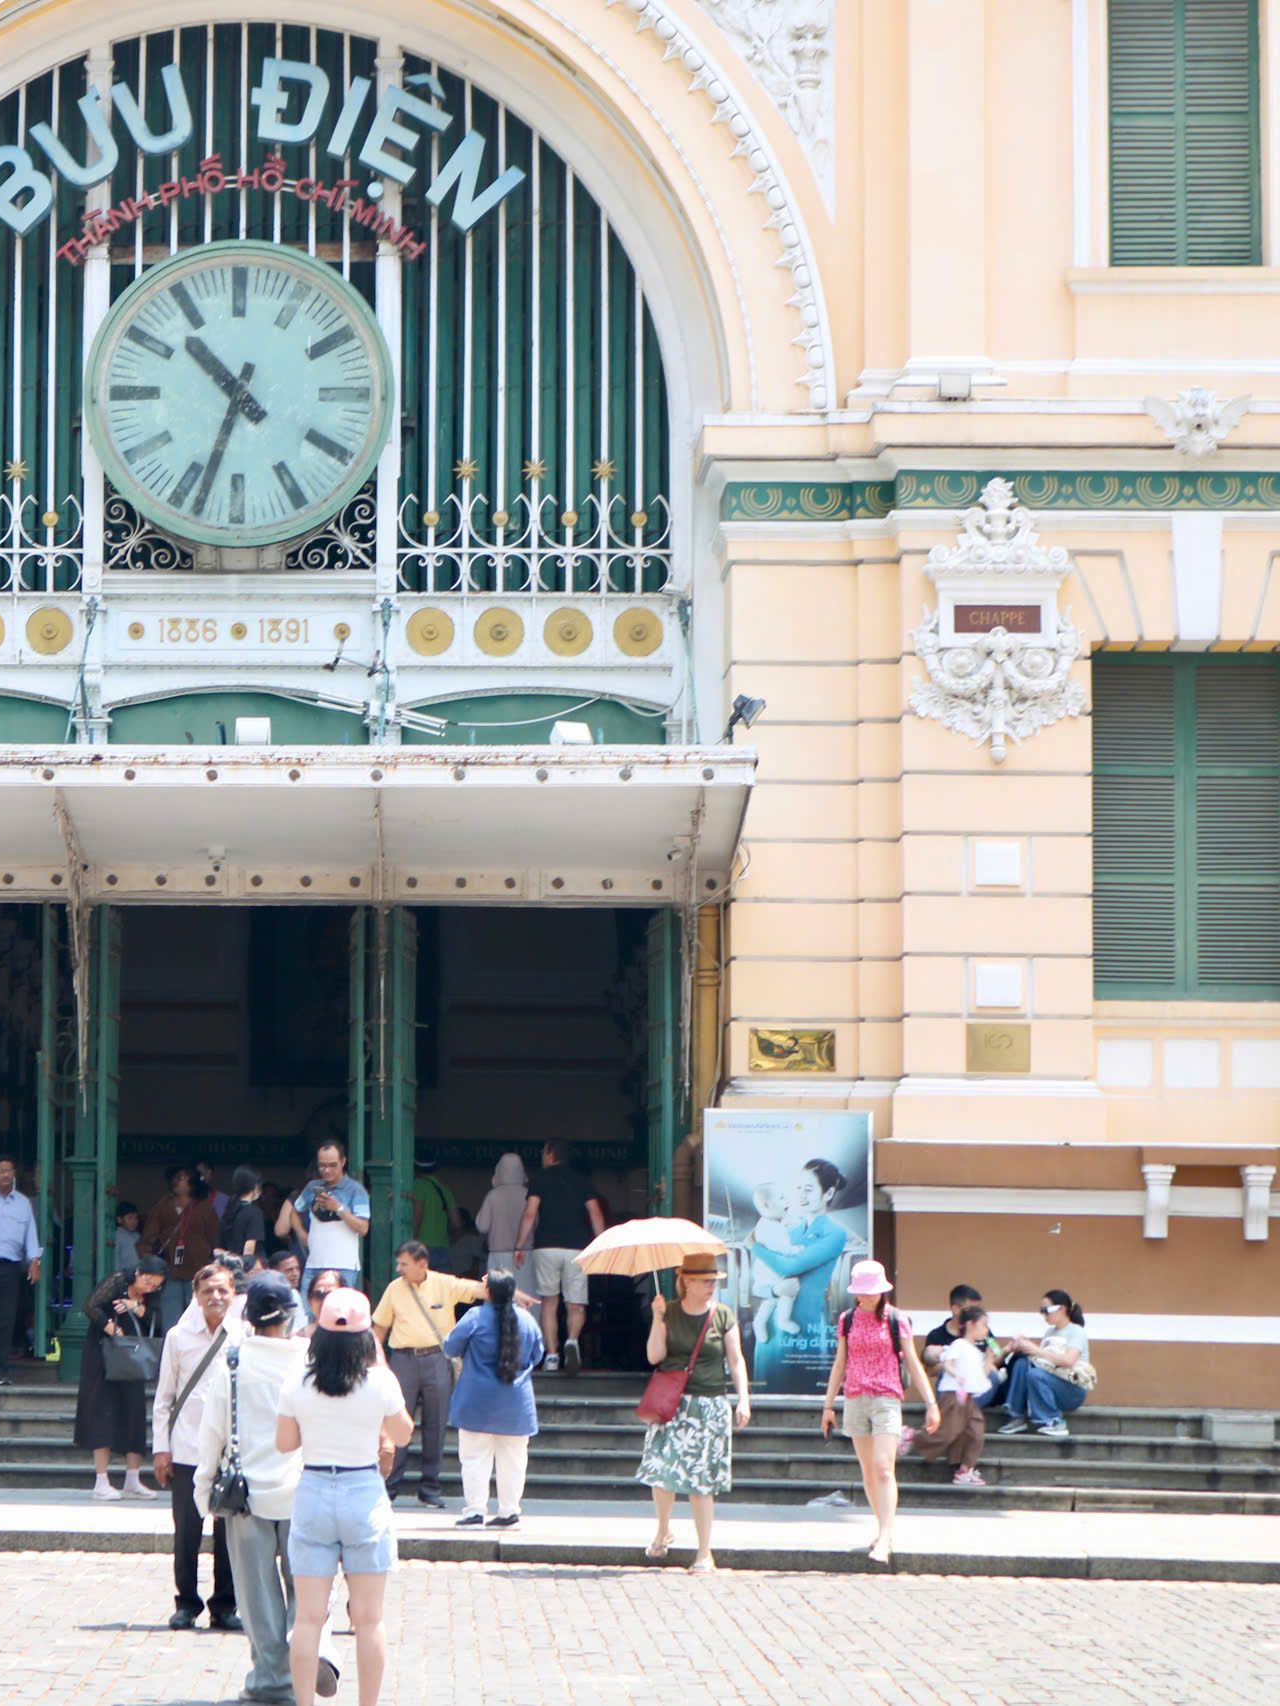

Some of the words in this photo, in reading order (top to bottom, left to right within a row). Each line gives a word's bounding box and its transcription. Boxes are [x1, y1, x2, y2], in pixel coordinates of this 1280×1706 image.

[251, 57, 526, 234] ĐIỆN
[56, 191, 153, 264] THÀNH
[158, 153, 225, 206] PHỐ
[237, 152, 287, 192] HỒ
[295, 177, 360, 212] CHÍ
[350, 198, 427, 261] MINH
[158, 618, 218, 643] 1886
[258, 618, 309, 643] 1891
[969, 611, 1024, 625] CHAPPE
